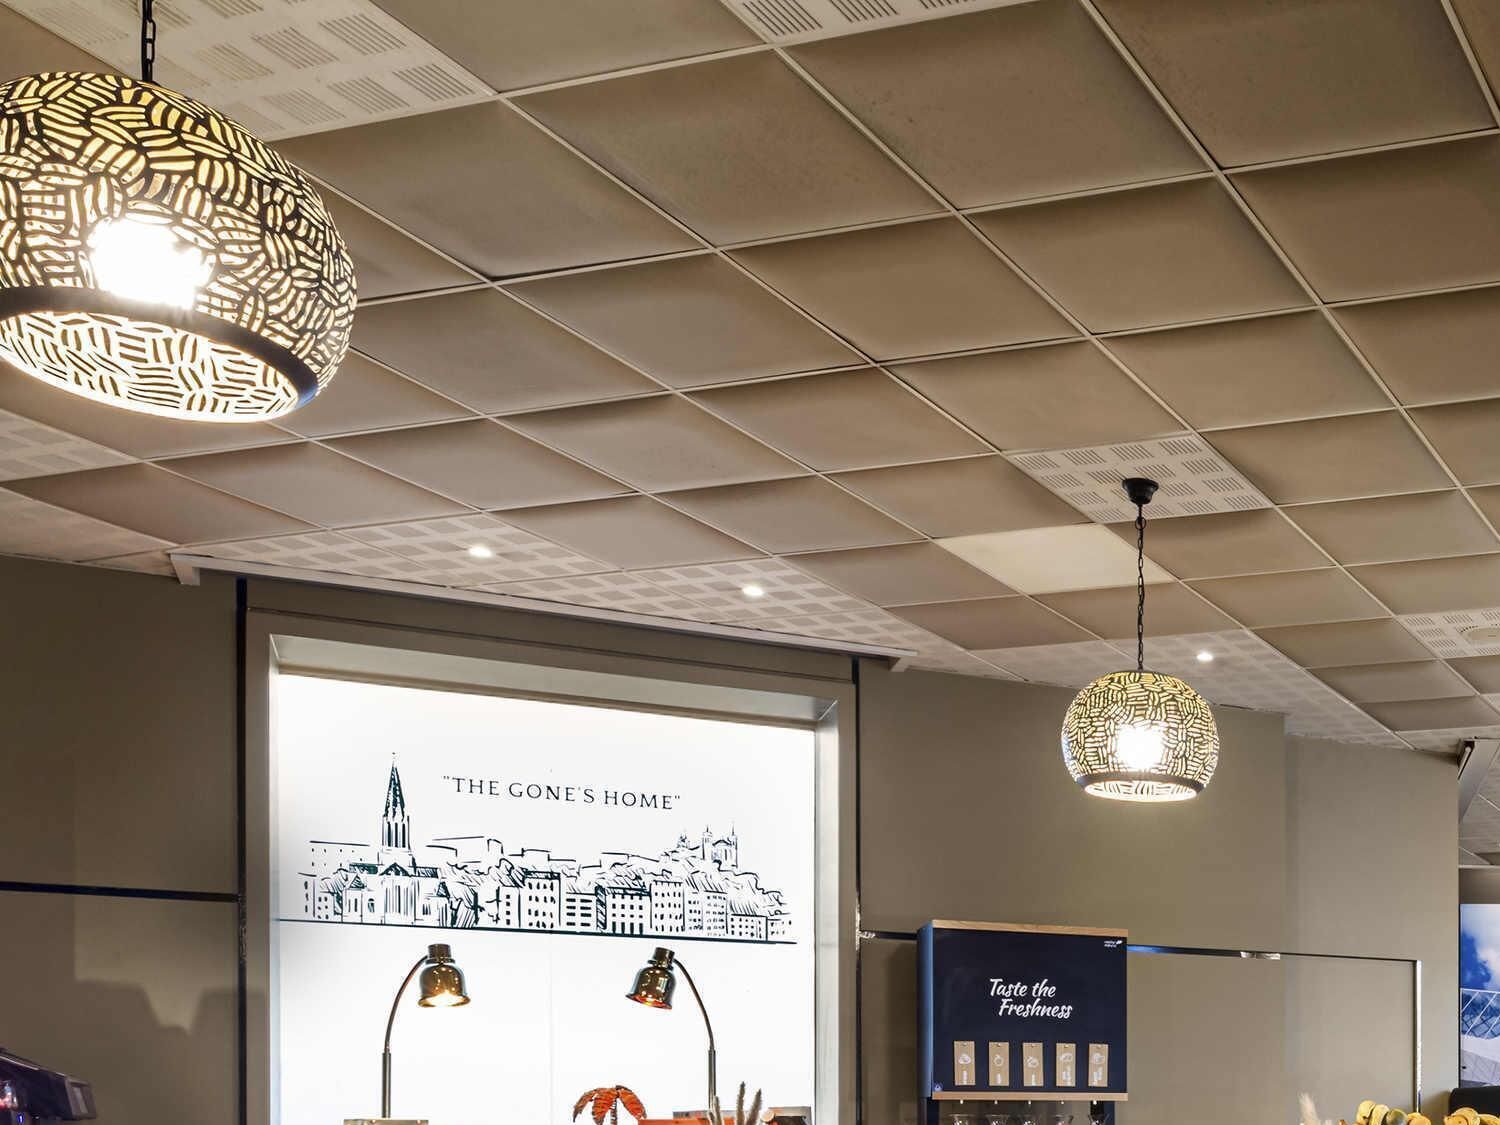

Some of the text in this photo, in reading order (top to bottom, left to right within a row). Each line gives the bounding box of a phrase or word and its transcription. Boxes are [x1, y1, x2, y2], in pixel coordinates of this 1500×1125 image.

[508, 782, 595, 804] GONE'S
[604, 790, 680, 810] HOME"
[989, 978, 1057, 998] Taste the
[998, 997, 1073, 1019] Freshness
